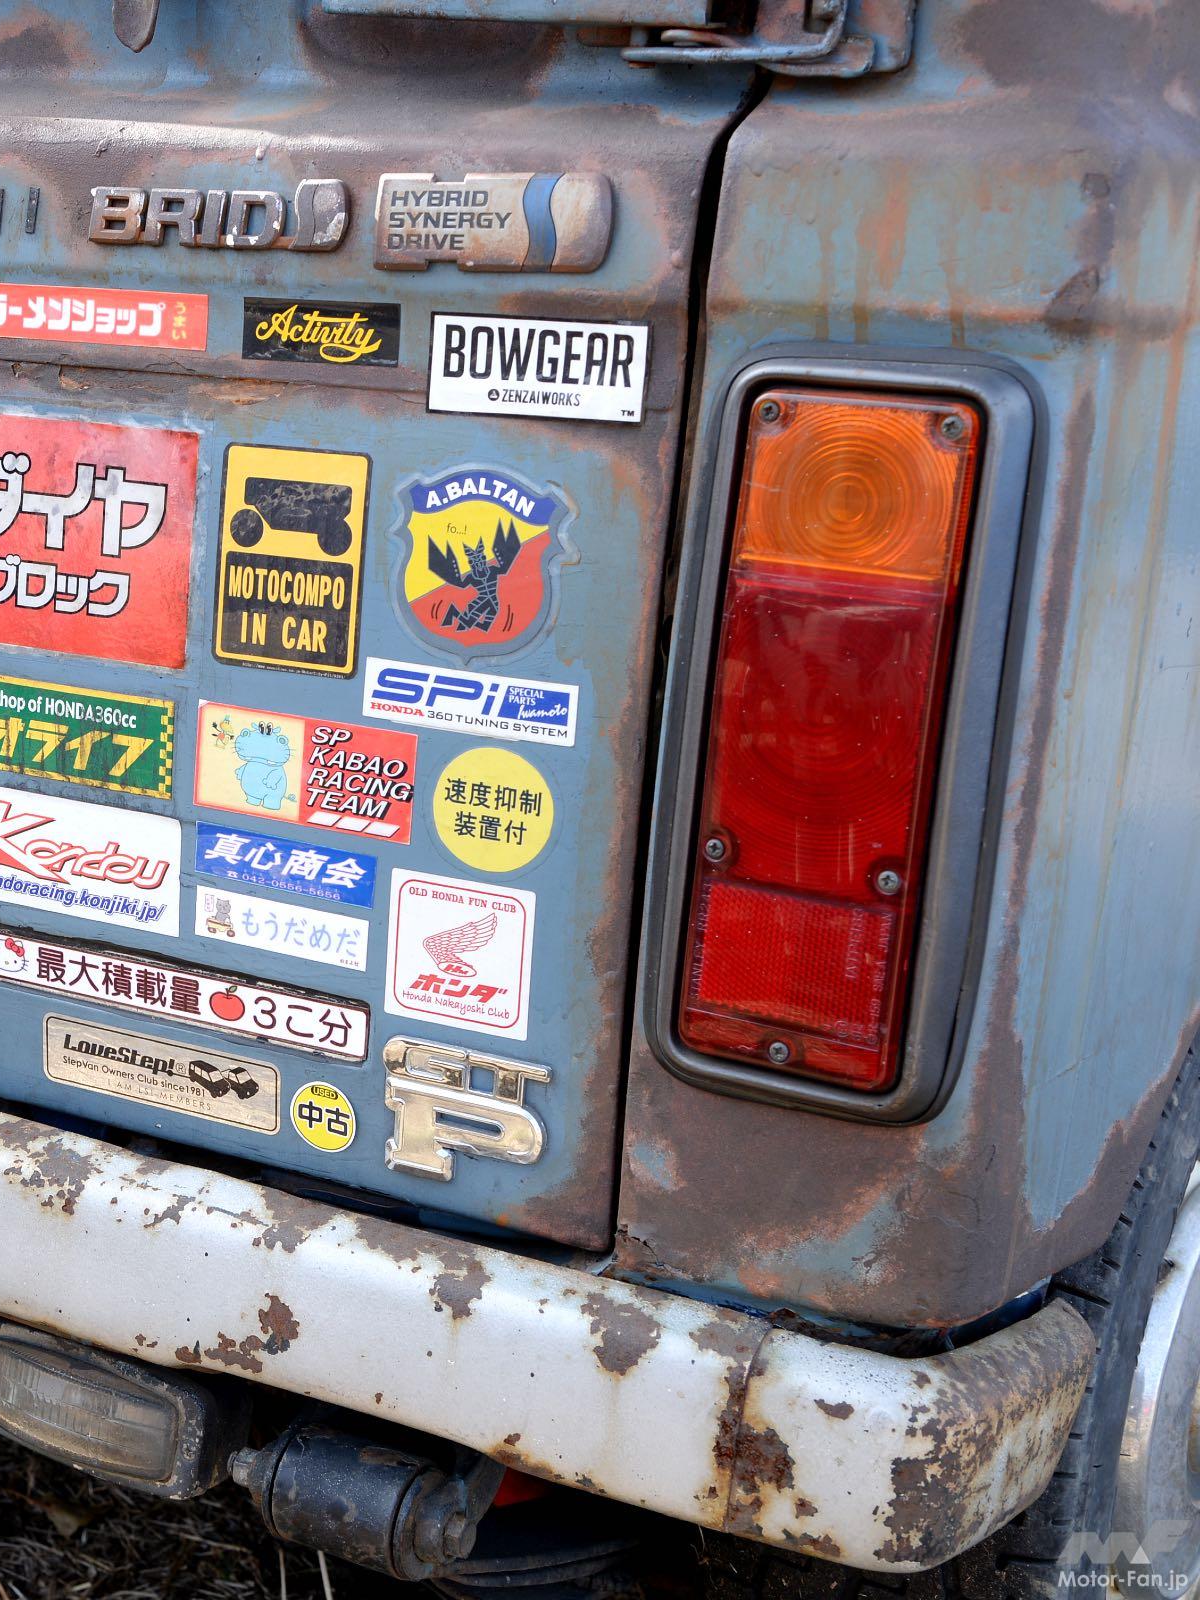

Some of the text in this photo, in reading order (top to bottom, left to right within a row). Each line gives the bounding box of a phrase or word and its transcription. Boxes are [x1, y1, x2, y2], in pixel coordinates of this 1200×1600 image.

[390, 190, 489, 207] HYBRID
[388, 212, 512, 229] SYNERGY
[387, 233, 465, 250] DRIVE
[255, 304, 381, 362] Activity
[443, 324, 634, 388] BOWGEAR
[426, 477, 536, 518] A.BALTAN
[228, 564, 346, 610] MOTOCOMPO
[240, 611, 328, 654] IN CAR
[27, 695, 43, 713] of
[508, 694, 537, 706] PARTS
[509, 686, 545, 699] SPECIAL
[370, 701, 568, 739] HONDA 360 TUNING SYSTEM
[517, 703, 568, 720] Iwamoto
[311, 726, 354, 747] SP
[309, 746, 408, 779] KABAO
[307, 767, 414, 803] RACING
[443, 777, 543, 817] 速度抑制
[306, 787, 392, 820] TEAM
[453, 811, 528, 846] 装置付
[204, 832, 367, 889] 真心商会
[408, 885, 517, 914] OLD HONDA FUN CLUB
[241, 907, 361, 958] もうだめだ
[35, 946, 202, 1016] 最大積載量
[409, 973, 508, 1004] ホンダ
[402, 989, 432, 1004] Honda
[487, 1006, 510, 1020] Club
[101, 1064, 135, 1081] Owners
[137, 1072, 158, 1086] Club
[313, 1087, 337, 1099] USED
[297, 1100, 351, 1137] 中古
